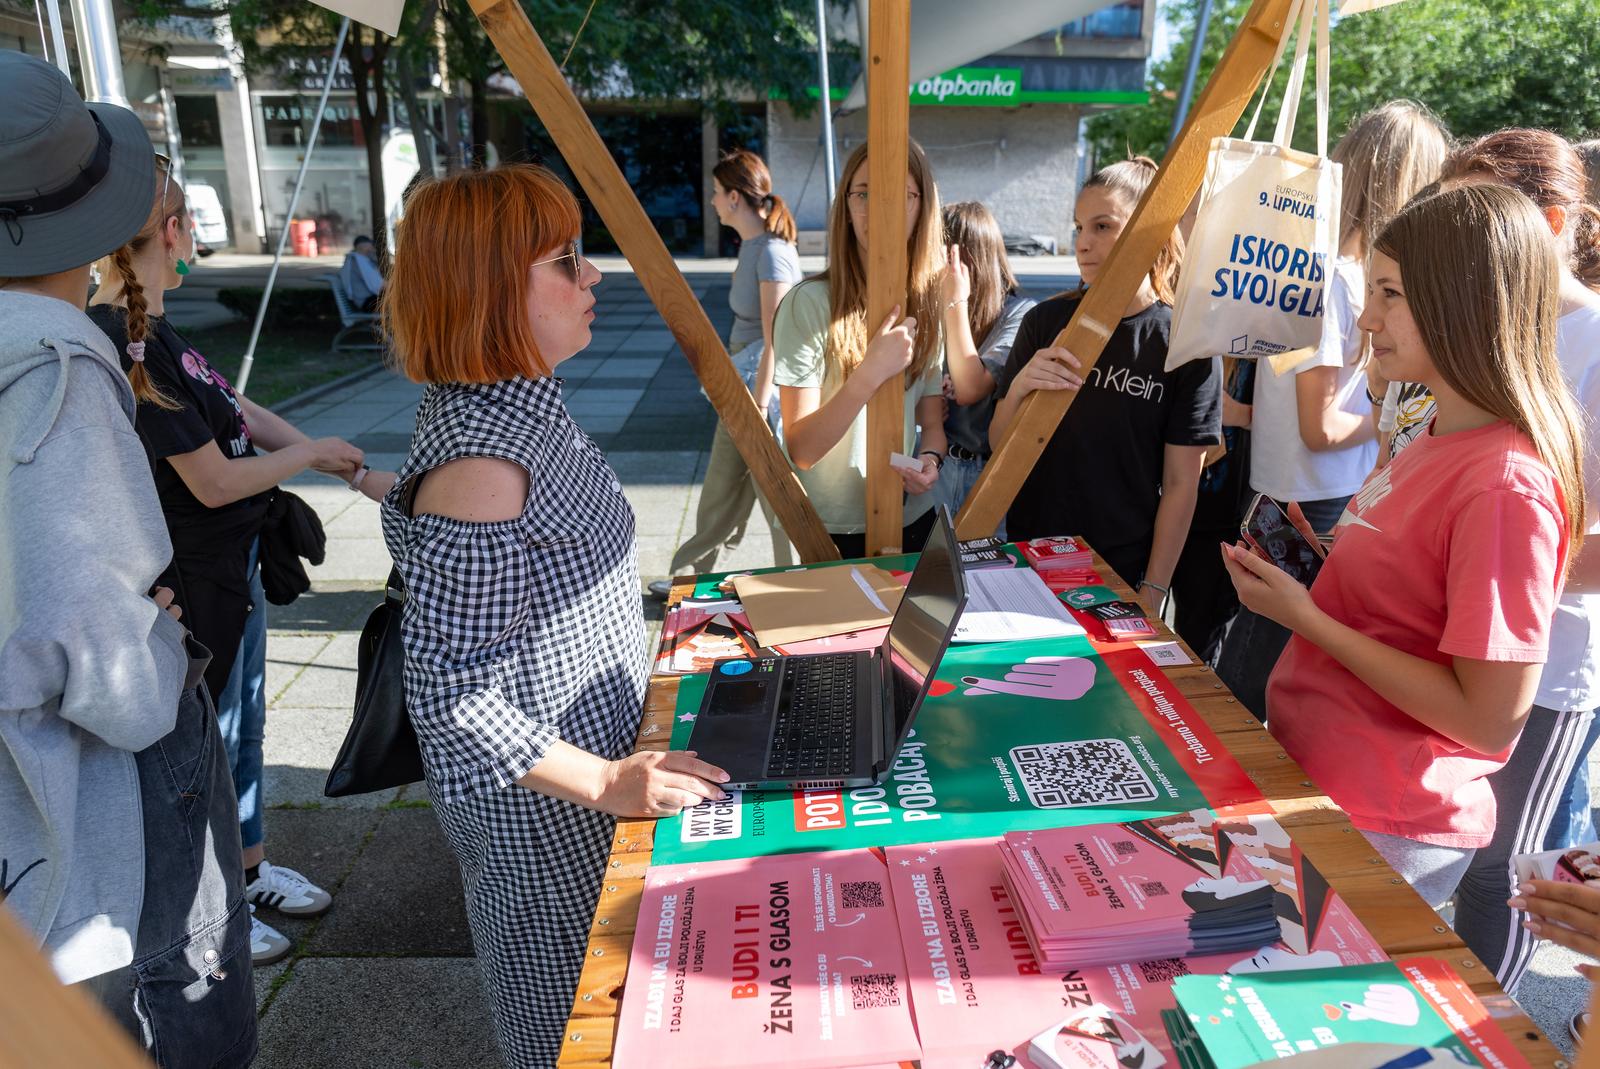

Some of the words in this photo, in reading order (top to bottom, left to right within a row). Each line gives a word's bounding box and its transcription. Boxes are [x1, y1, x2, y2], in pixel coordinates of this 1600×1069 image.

[918, 73, 1016, 102] otpbanka
[1276, 184, 1314, 201] EUROPSKI
[1259, 191, 1270, 207] 9.
[1273, 194, 1315, 219] LIPNJA
[1211, 267, 1276, 307] SVOJ
[1103, 365, 1164, 403] Klein
[1129, 668, 1160, 696] potpisa!
[1153, 692, 1181, 721] milijun
[1170, 719, 1185, 728] 1
[1177, 725, 1214, 764] Trebamo
[850, 783, 889, 815] DO
[1000, 775, 1020, 802] Skeniraj
[692, 796, 712, 816] VO
[714, 790, 734, 816] CHO
[689, 818, 710, 838] MY
[712, 818, 733, 836] MY
[854, 816, 892, 827] I
[1063, 854, 1078, 864] TI
[1074, 842, 1103, 877] GLASOM
[932, 866, 947, 885] ŽENA
[1074, 872, 1099, 898] BUDI
[683, 887, 696, 905] ŽENA
[911, 874, 936, 917] IZBORE
[936, 885, 954, 919] POLOŽAJ
[1101, 884, 1125, 909] ŽENA
[658, 894, 678, 939] IZBORE
[680, 906, 693, 941] POLOŽAJ
[735, 904, 760, 922] TI
[769, 881, 791, 952] GLASOM
[922, 920, 941, 936] EU
[946, 920, 961, 944] BOLJI
[960, 909, 976, 943] DRUŠTVU
[655, 942, 672, 958] EU
[677, 942, 689, 966] BOLJI
[692, 930, 706, 965] DRUŠTVU
[927, 938, 946, 959] NA
[953, 944, 965, 957] ZA
[651, 960, 669, 980] NA
[676, 966, 686, 978] ZA
[693, 965, 703, 973] U
[731, 942, 760, 999] BUDI
[770, 957, 792, 968] S
[956, 958, 971, 980] GLAS
[673, 979, 685, 1004] GLAS
[963, 982, 977, 1001] DAJ
[671, 1006, 683, 1026] DAJ
[763, 975, 793, 1034] ŽENA
